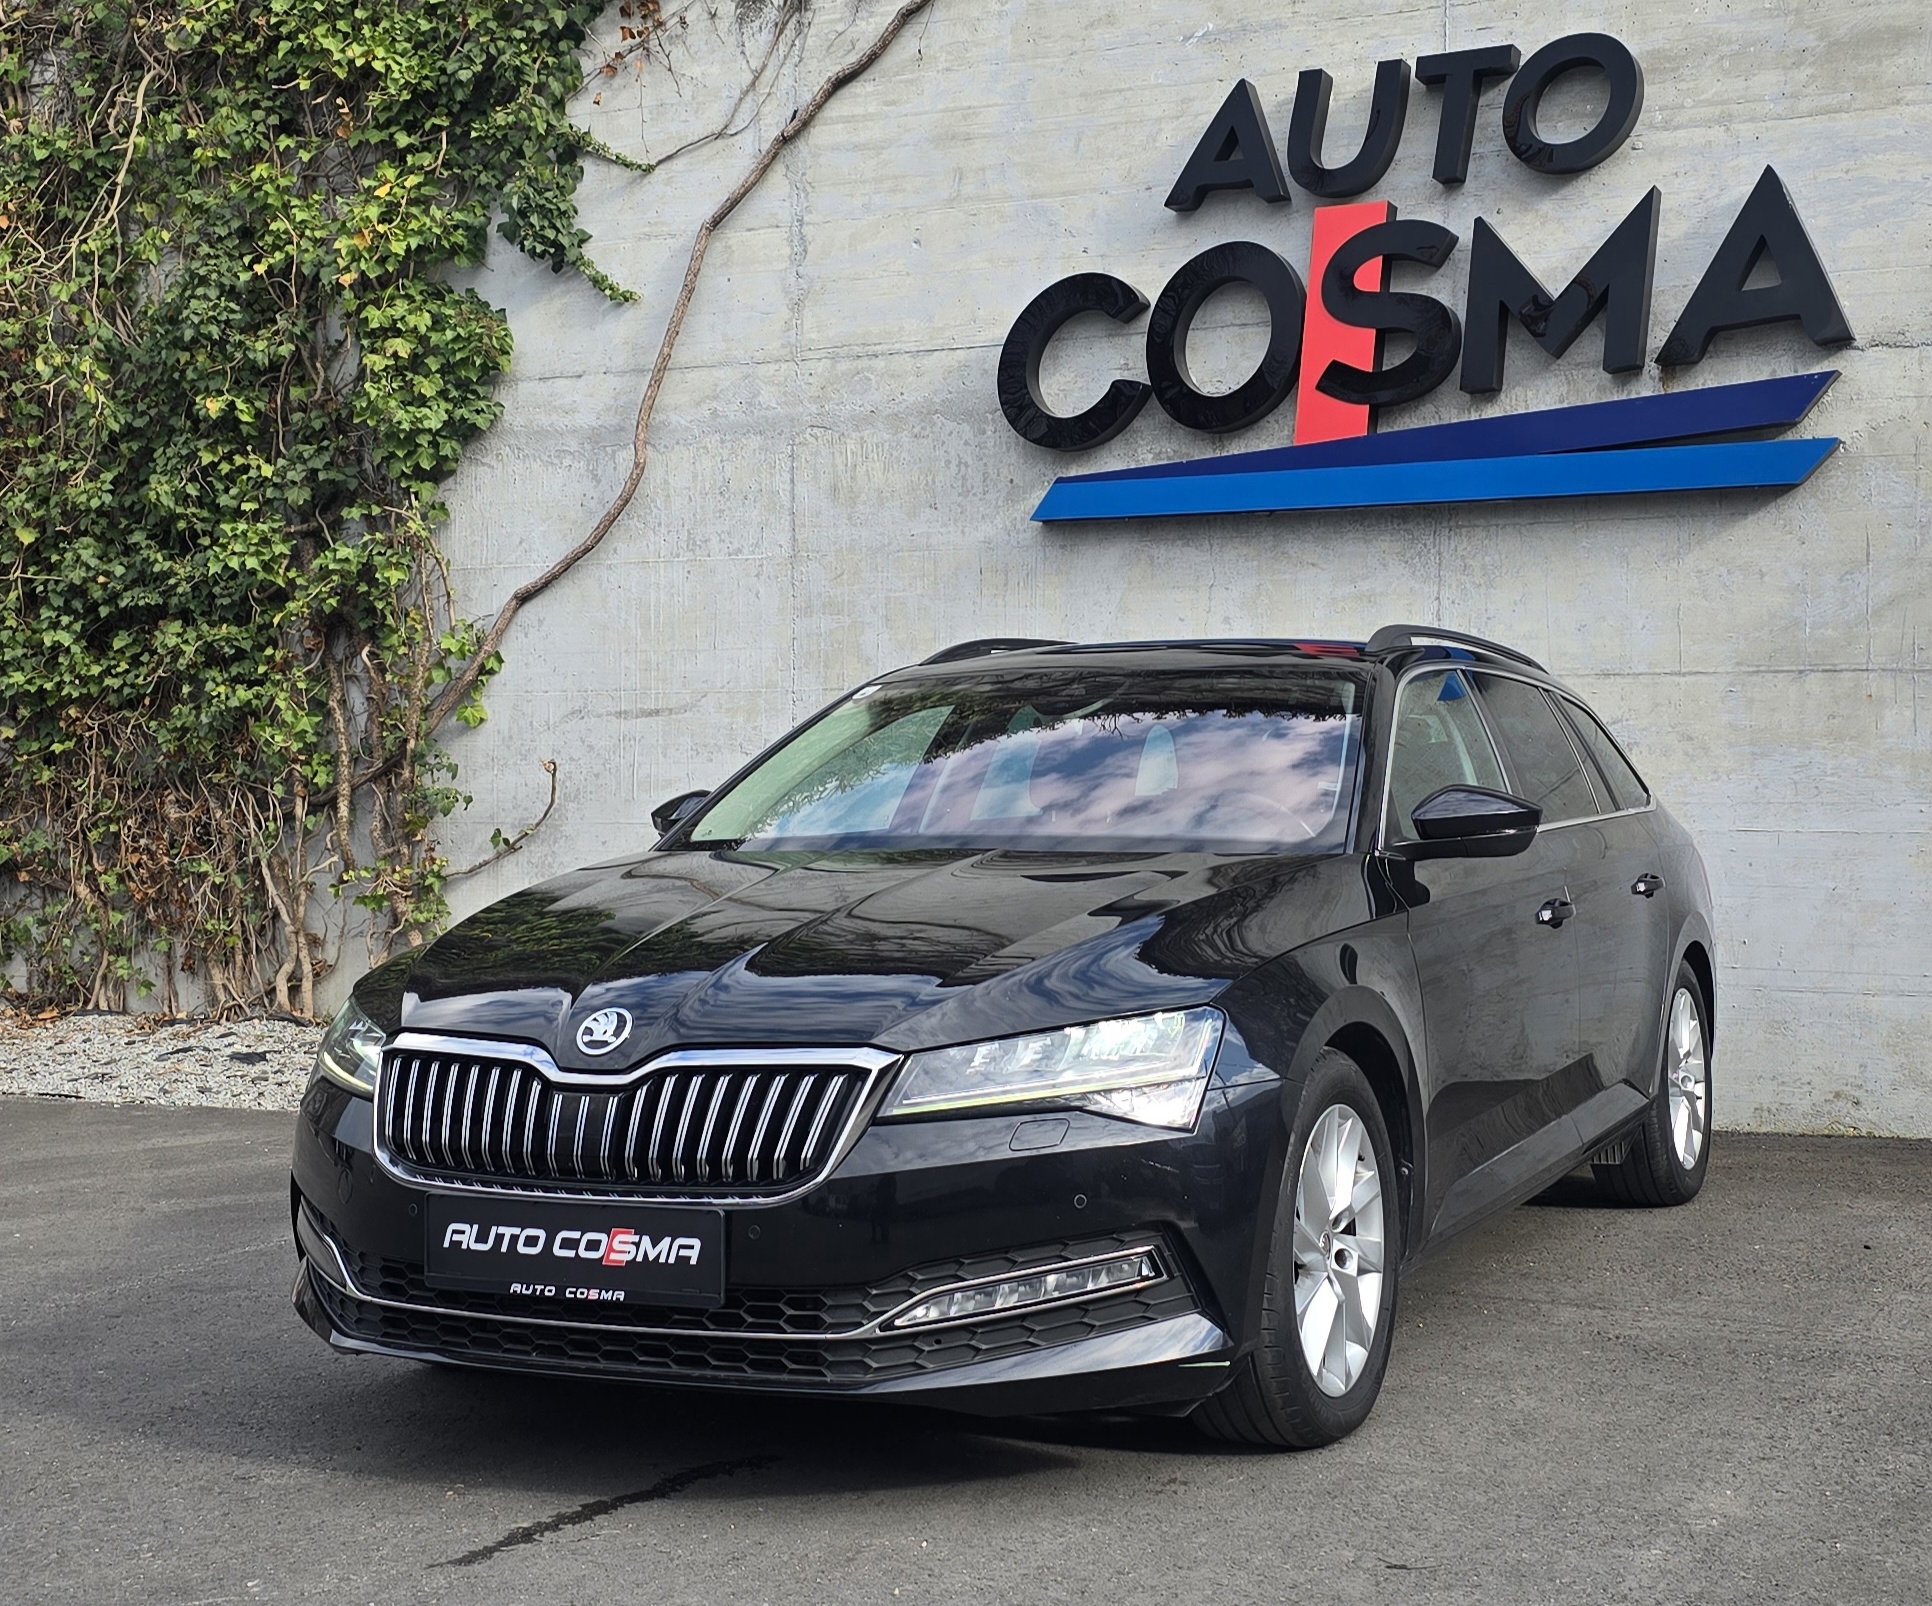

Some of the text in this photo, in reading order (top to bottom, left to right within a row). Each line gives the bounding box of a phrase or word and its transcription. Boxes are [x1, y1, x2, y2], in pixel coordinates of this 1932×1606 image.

[1164, 32, 1644, 212] AUTO
[997, 164, 1855, 452] COSMA
[443, 1222, 702, 1266] AUTO COSMA
[510, 1283, 625, 1301] AUTO COSMA
